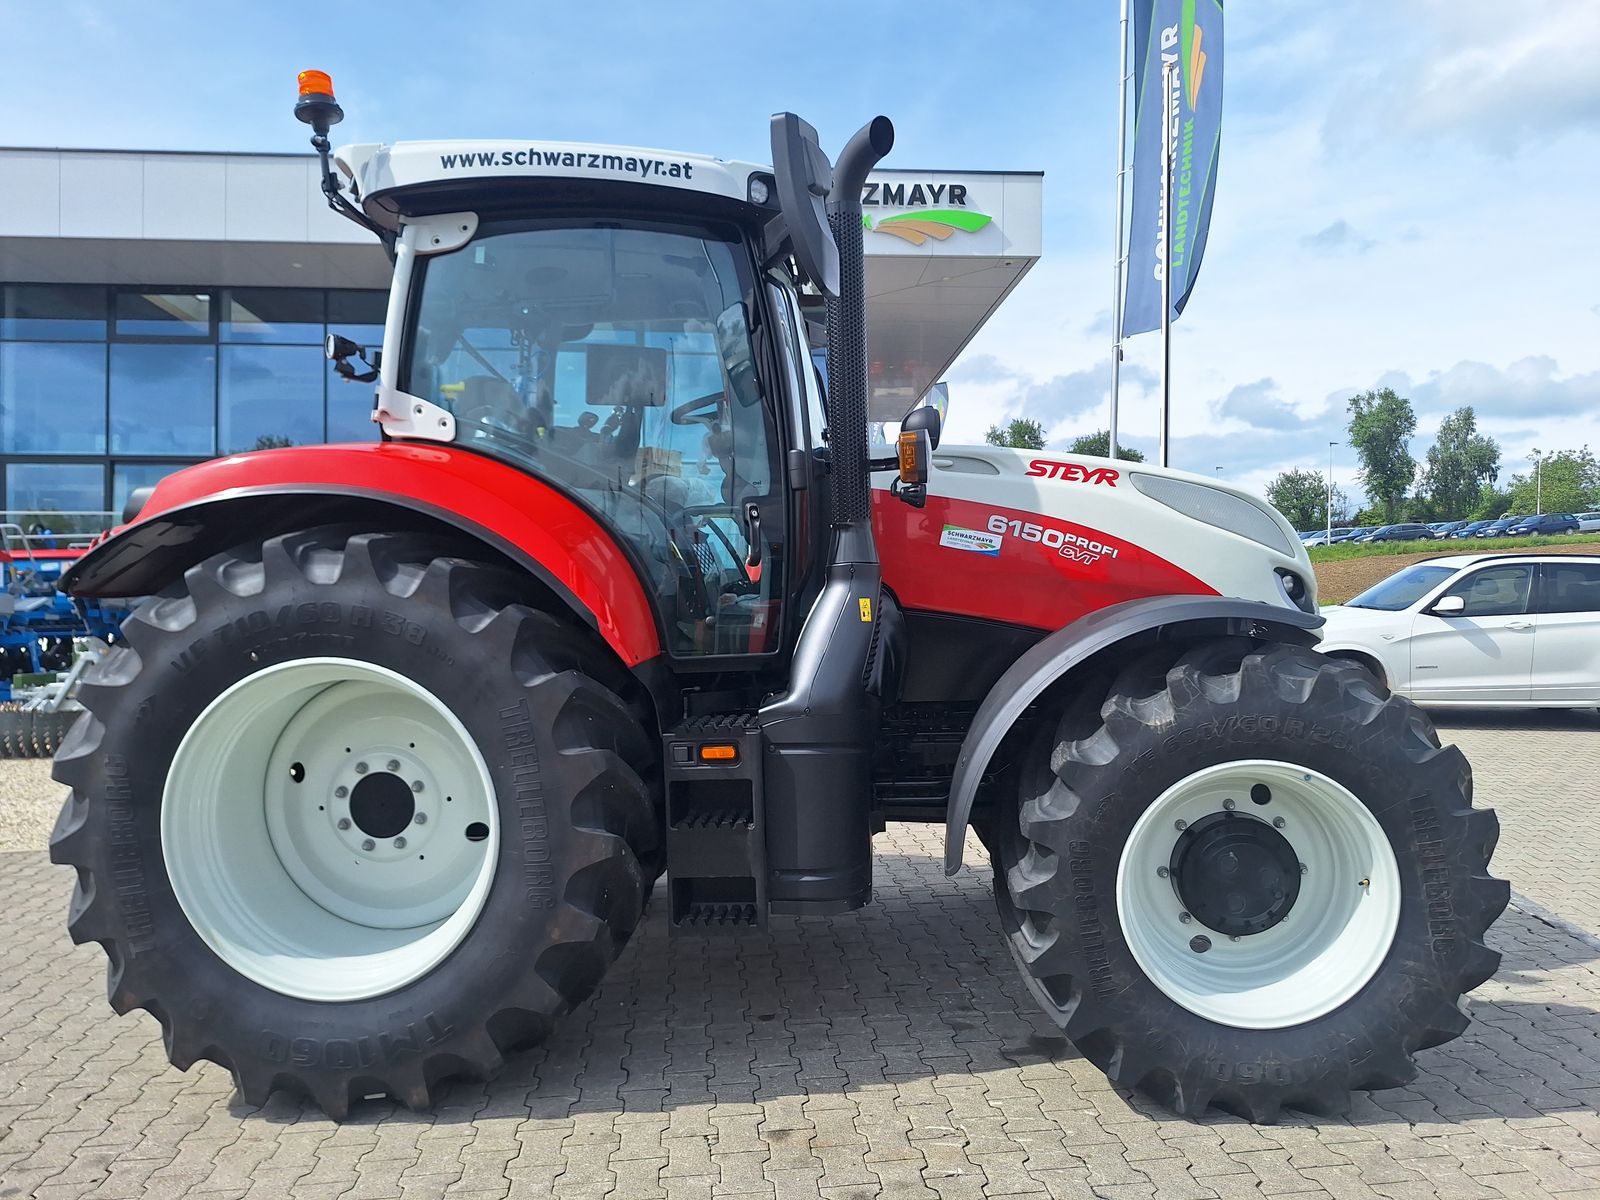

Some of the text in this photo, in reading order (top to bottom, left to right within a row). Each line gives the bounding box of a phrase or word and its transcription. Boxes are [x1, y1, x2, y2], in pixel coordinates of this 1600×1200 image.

[440, 148, 693, 180] www.schwarzmayr.at
[1172, 116, 1194, 268] LANDTECHNIK
[1025, 459, 1120, 488] STEYR
[947, 530, 994, 545] SCHWARZMAYR
[987, 514, 1119, 559] 6150 PROFI
[1058, 545, 1100, 566] CVT
[382, 609, 429, 646] 38
[499, 697, 557, 910] TRELLEBORG
